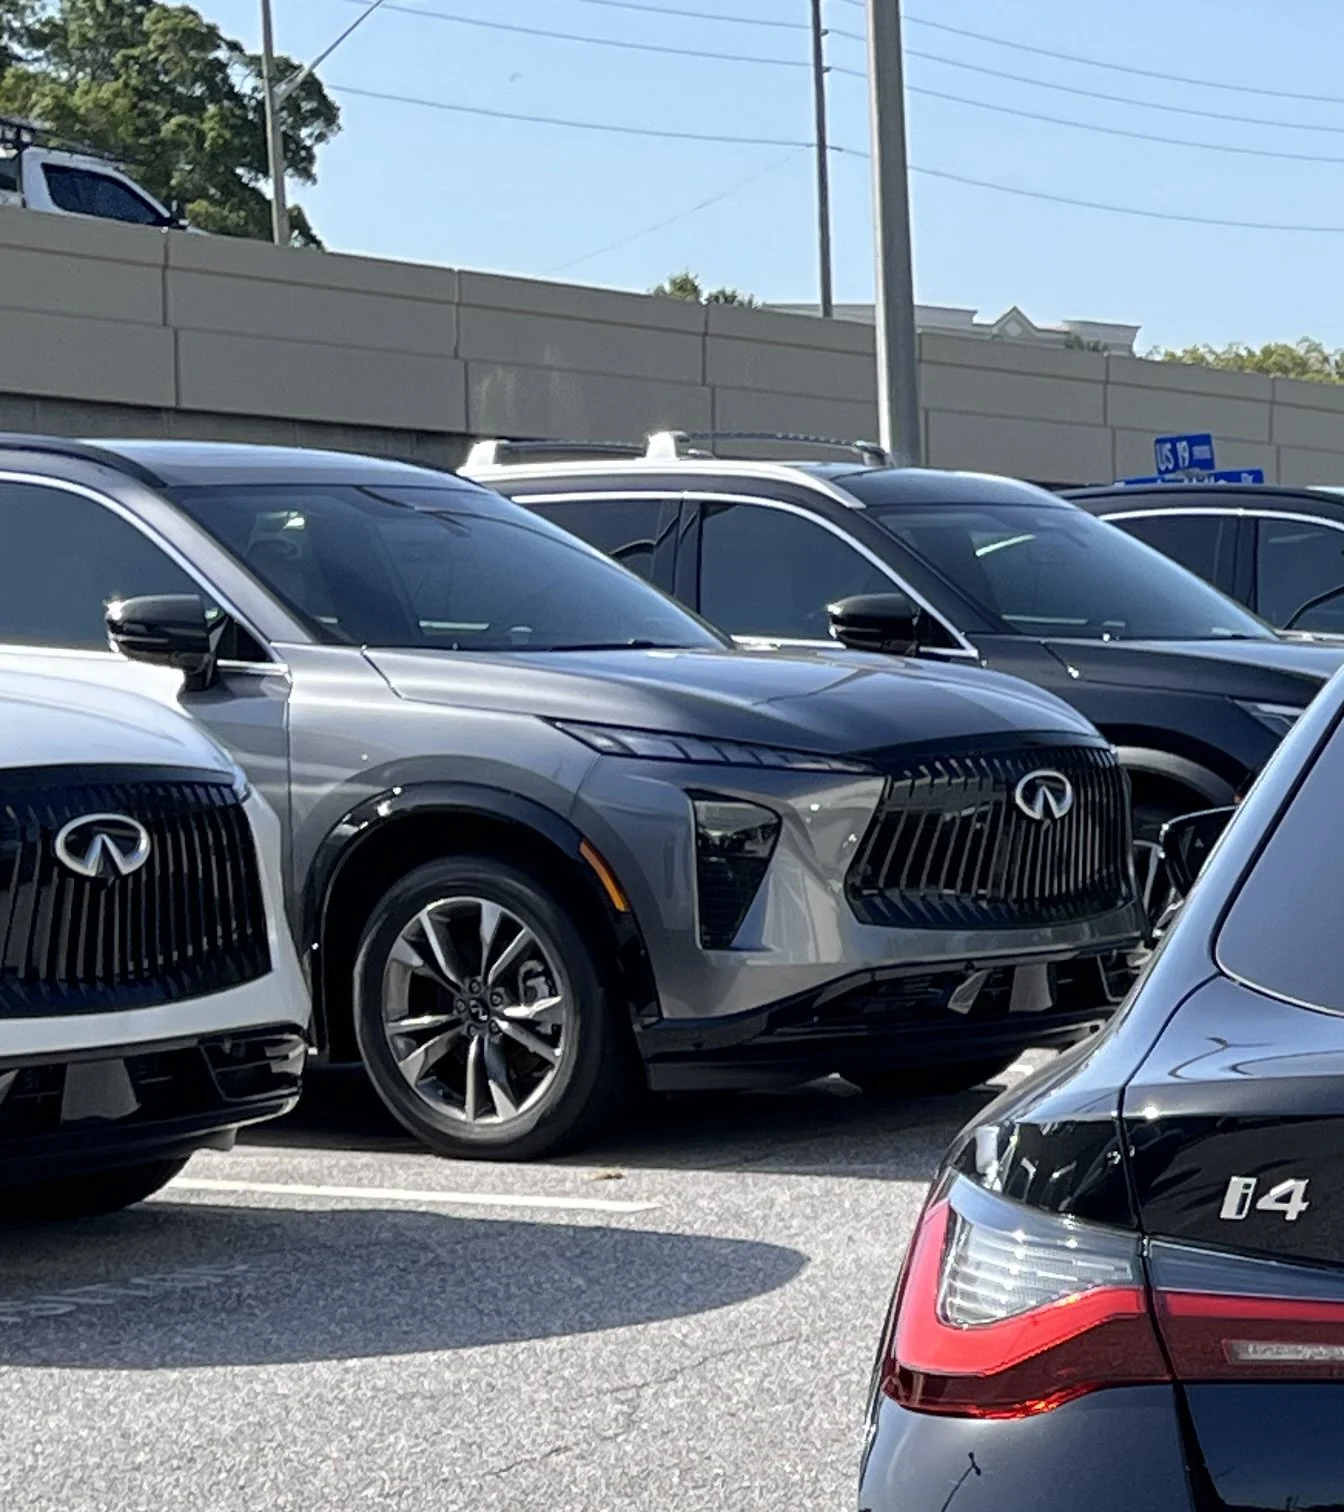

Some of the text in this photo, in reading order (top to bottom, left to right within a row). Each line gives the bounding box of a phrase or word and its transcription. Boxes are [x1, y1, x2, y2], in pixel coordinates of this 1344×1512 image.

[1156, 442, 1175, 471] US
[1176, 440, 1190, 468] 19
[1219, 1176, 1310, 1221] i4
